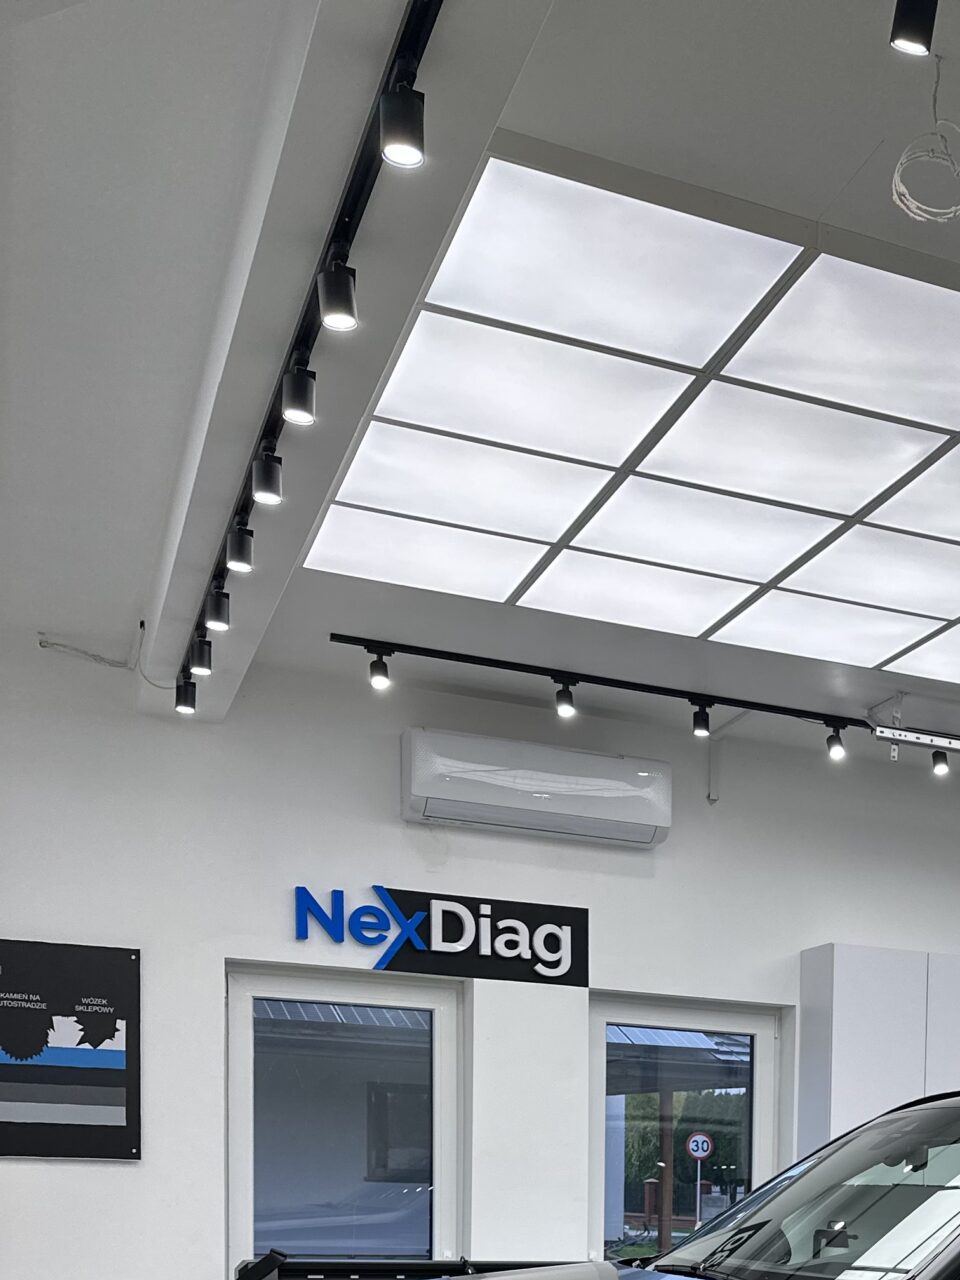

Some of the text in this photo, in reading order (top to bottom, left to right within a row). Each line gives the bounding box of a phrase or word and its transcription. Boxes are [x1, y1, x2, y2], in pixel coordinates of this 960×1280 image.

[295, 884, 572, 977] NexDiag
[29, 993, 41, 1001] NA
[81, 997, 108, 1005] WÓZEK
[75, 1005, 114, 1014] SKLEPOWY
[691, 1139, 710, 1152] 30
